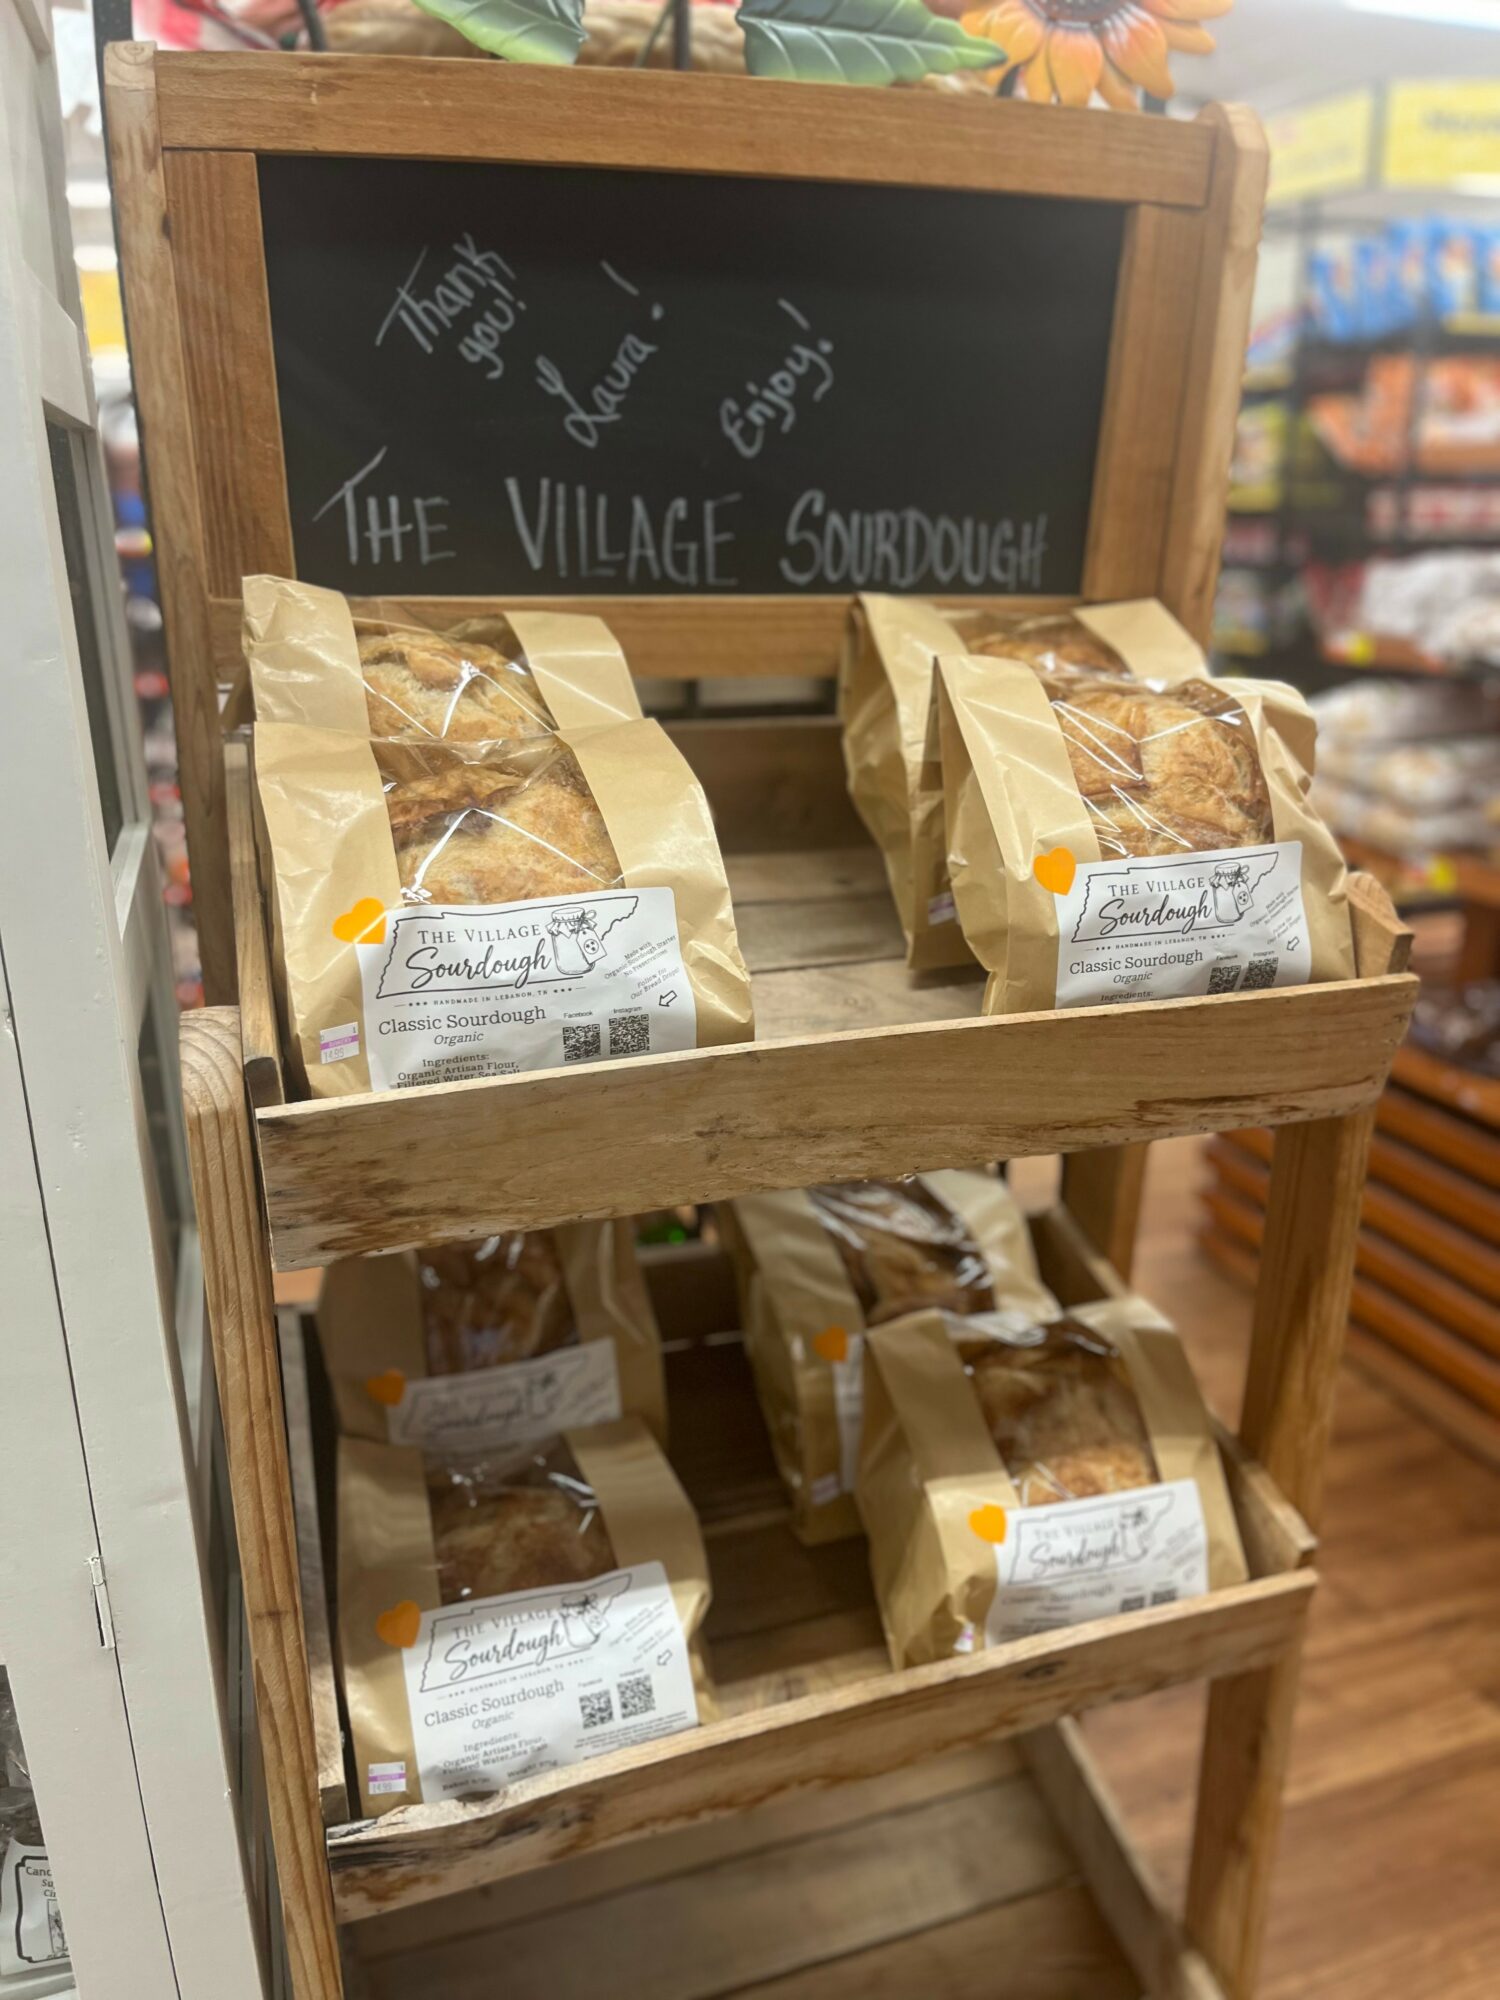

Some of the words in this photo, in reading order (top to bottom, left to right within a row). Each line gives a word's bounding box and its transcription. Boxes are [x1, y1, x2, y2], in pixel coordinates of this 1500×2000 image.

[375, 233, 516, 354] Thank
[458, 280, 526, 379] you!
[720, 298, 834, 458] Enjoy!
[313, 446, 455, 565] THE
[505, 477, 741, 587] VILLAGE
[780, 489, 1048, 590] SOURDOUGH
[1108, 883, 1139, 897] THE
[1146, 877, 1206, 894] VILLAGE
[1099, 890, 1213, 935] Sourdough
[418, 930, 456, 945] THE
[464, 924, 542, 942] VILLAGE
[406, 938, 552, 989] Sourdough
[1069, 957, 1121, 975] Classic
[1125, 950, 1203, 969] Sourdough
[1113, 971, 1153, 985] Organic
[433, 996, 479, 1006] HANDMADE
[482, 995, 491, 1003] IN
[613, 1006, 643, 1014] Instagram
[378, 1016, 442, 1035] Classic
[447, 1006, 547, 1029] Sourdough
[563, 1011, 593, 1019] Facebook
[434, 1032, 484, 1047] Organic
[398, 1069, 441, 1081] Organic
[444, 1063, 484, 1075] Artisan
[487, 1061, 519, 1070] Flour,
[422, 1053, 490, 1068] Ingredients:
[453, 1624, 487, 1640] THE
[491, 1609, 555, 1629] VILLAGE
[445, 1619, 566, 1681] Sourdough
[424, 1700, 479, 1727] Classic
[481, 1679, 565, 1713] Sourdough
[472, 1710, 515, 1730] Organic
[443, 1753, 480, 1768] Organic
[483, 1743, 517, 1757] Artisan
